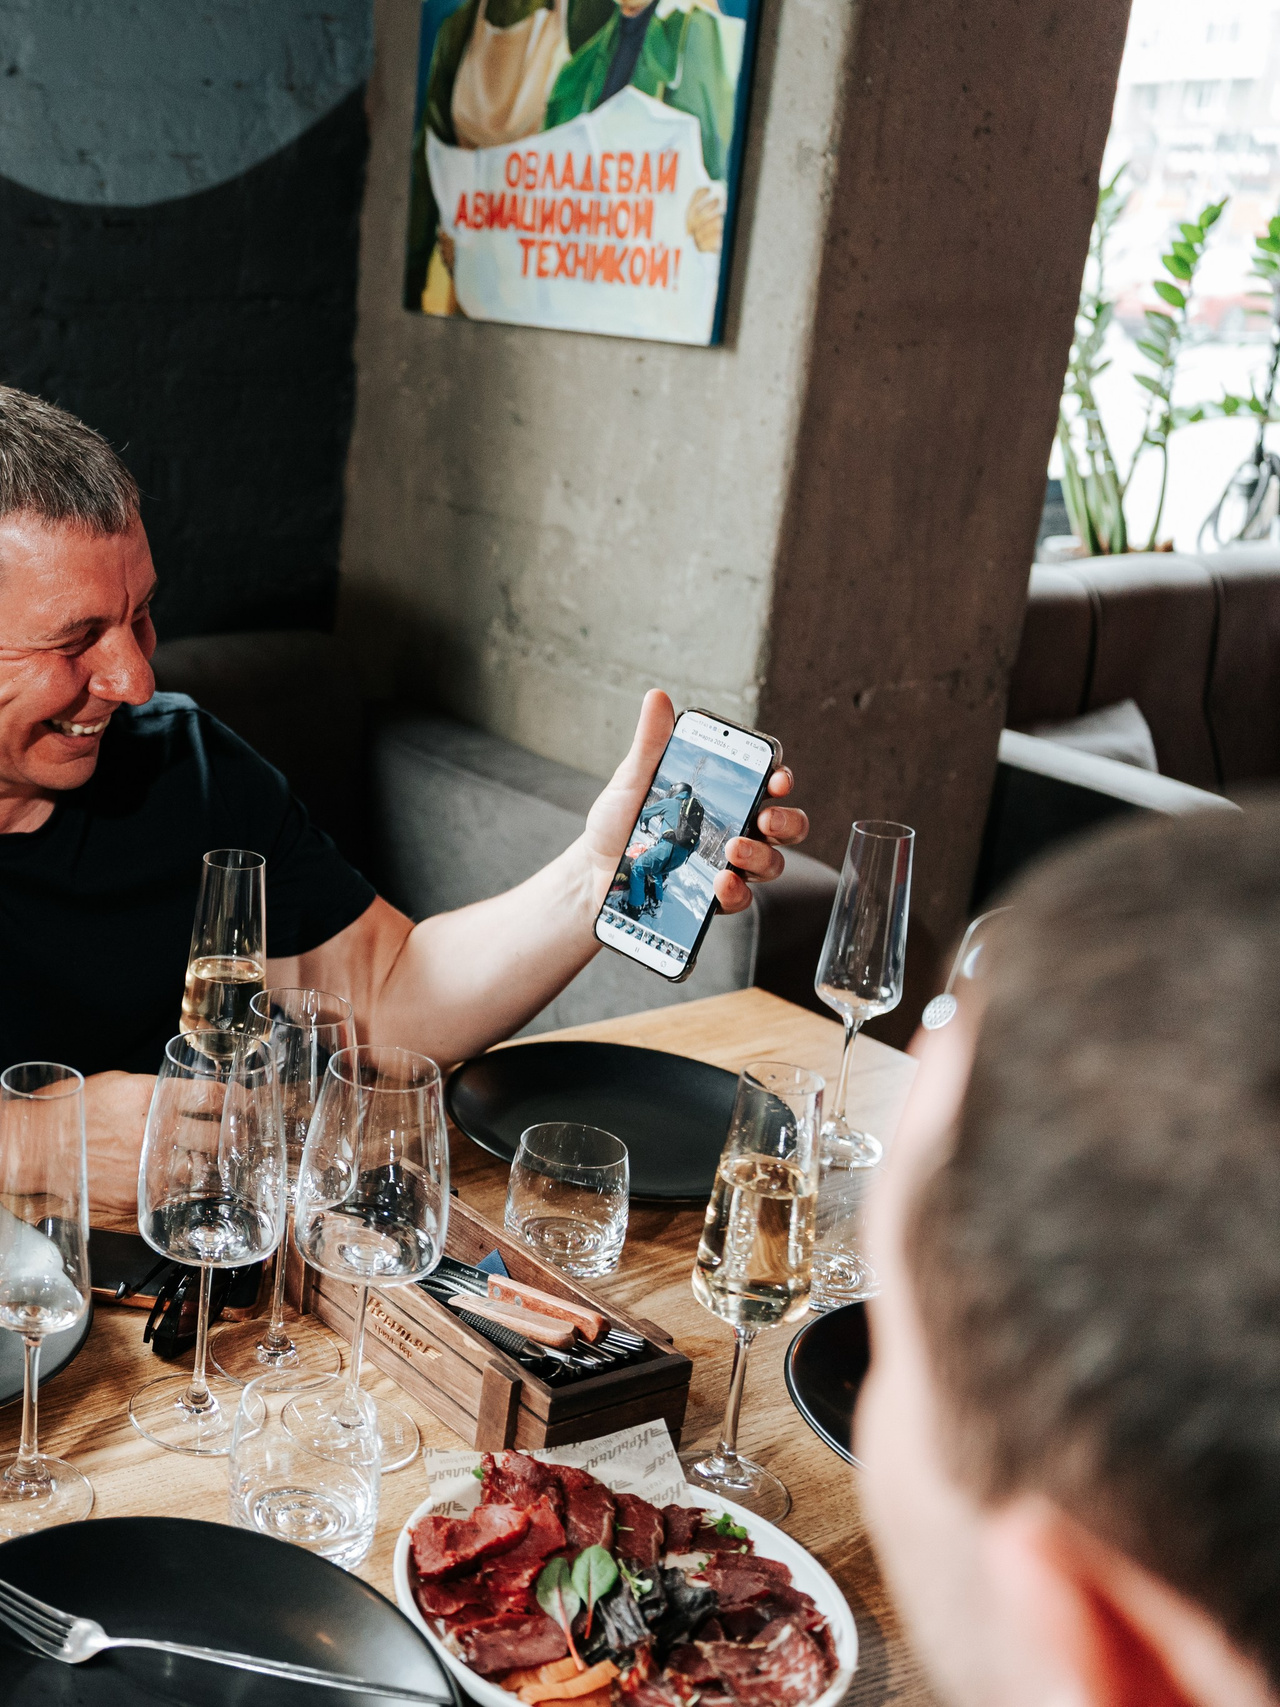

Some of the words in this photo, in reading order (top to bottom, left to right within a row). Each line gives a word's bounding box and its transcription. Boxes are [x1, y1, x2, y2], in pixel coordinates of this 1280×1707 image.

[504, 149, 680, 193] ОВЛАДЕВАЙ
[453, 191, 656, 240] АВИАЦИОННОЙ
[517, 237, 682, 291] ТЕХНИКОЙ!
